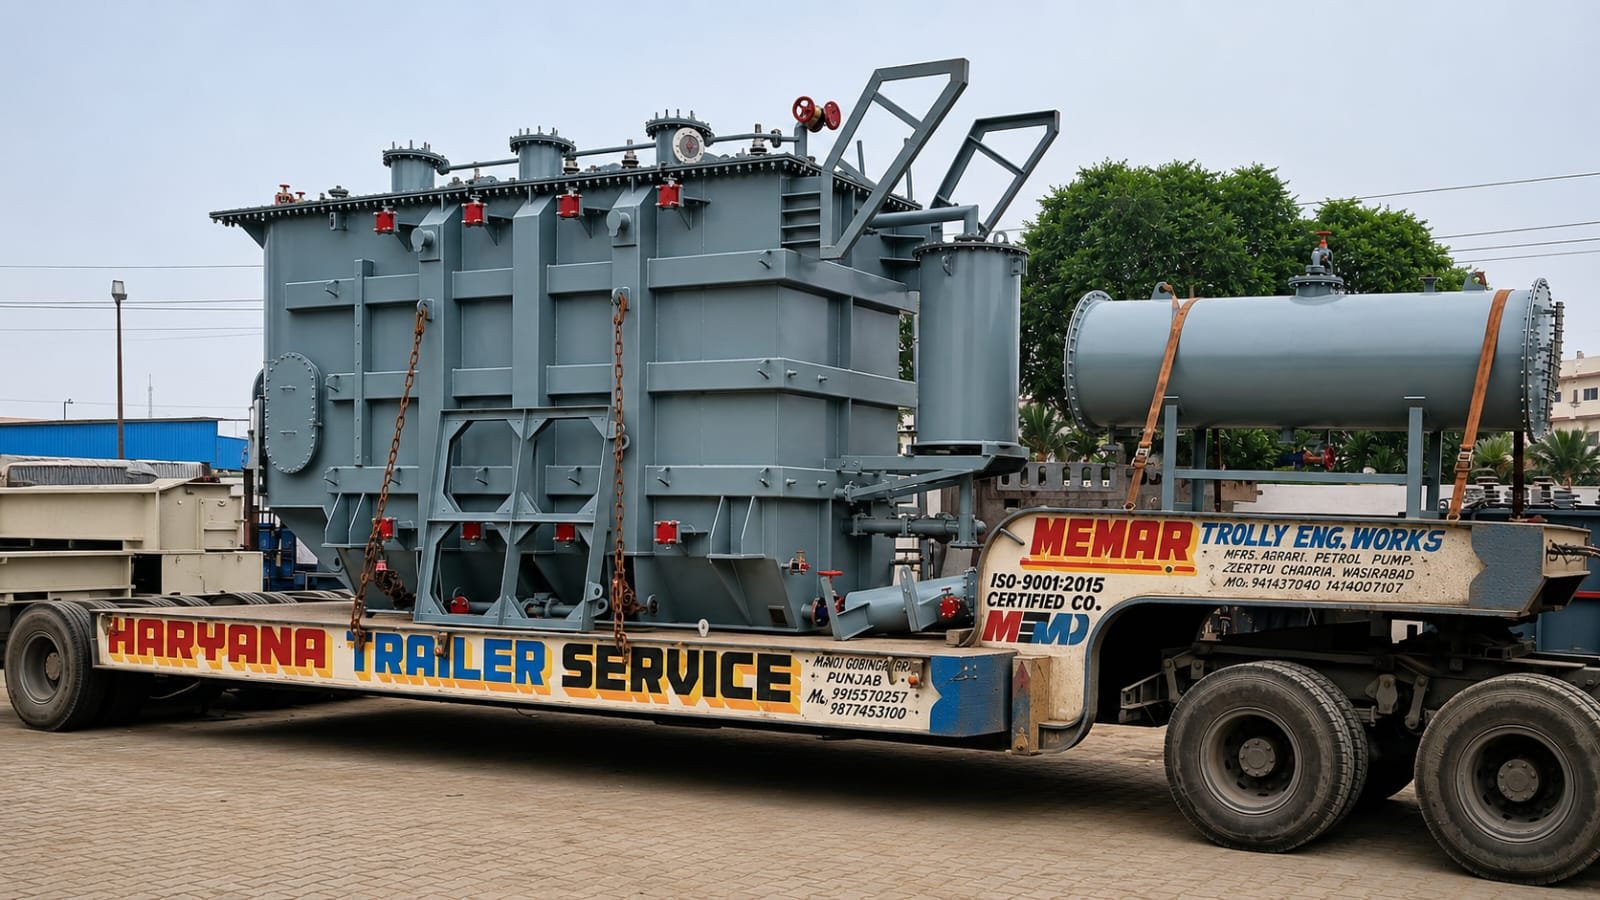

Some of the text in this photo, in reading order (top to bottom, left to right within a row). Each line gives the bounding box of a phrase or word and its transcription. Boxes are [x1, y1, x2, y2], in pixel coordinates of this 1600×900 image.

[1030, 517, 1193, 561] MEMAR
[1201, 522, 1290, 547] TROLLY
[1350, 529, 1446, 552] WORKS
[1313, 552, 1361, 564] PETROL
[1371, 554, 1414, 566] PUMP.
[1342, 567, 1415, 580] WASIRABAD
[990, 573, 1105, 593] ISO-9001:2015
[1251, 577, 1320, 591] 941437040
[1326, 580, 1404, 593] 1414007107
[987, 592, 1103, 611] CERTIFIED CO.
[109, 617, 793, 703] HARYANA TRAILER SERVICE
[826, 671, 882, 686] PUNJAB
[831, 687, 908, 703] 9915570257
[829, 702, 907, 719] 9877453100
